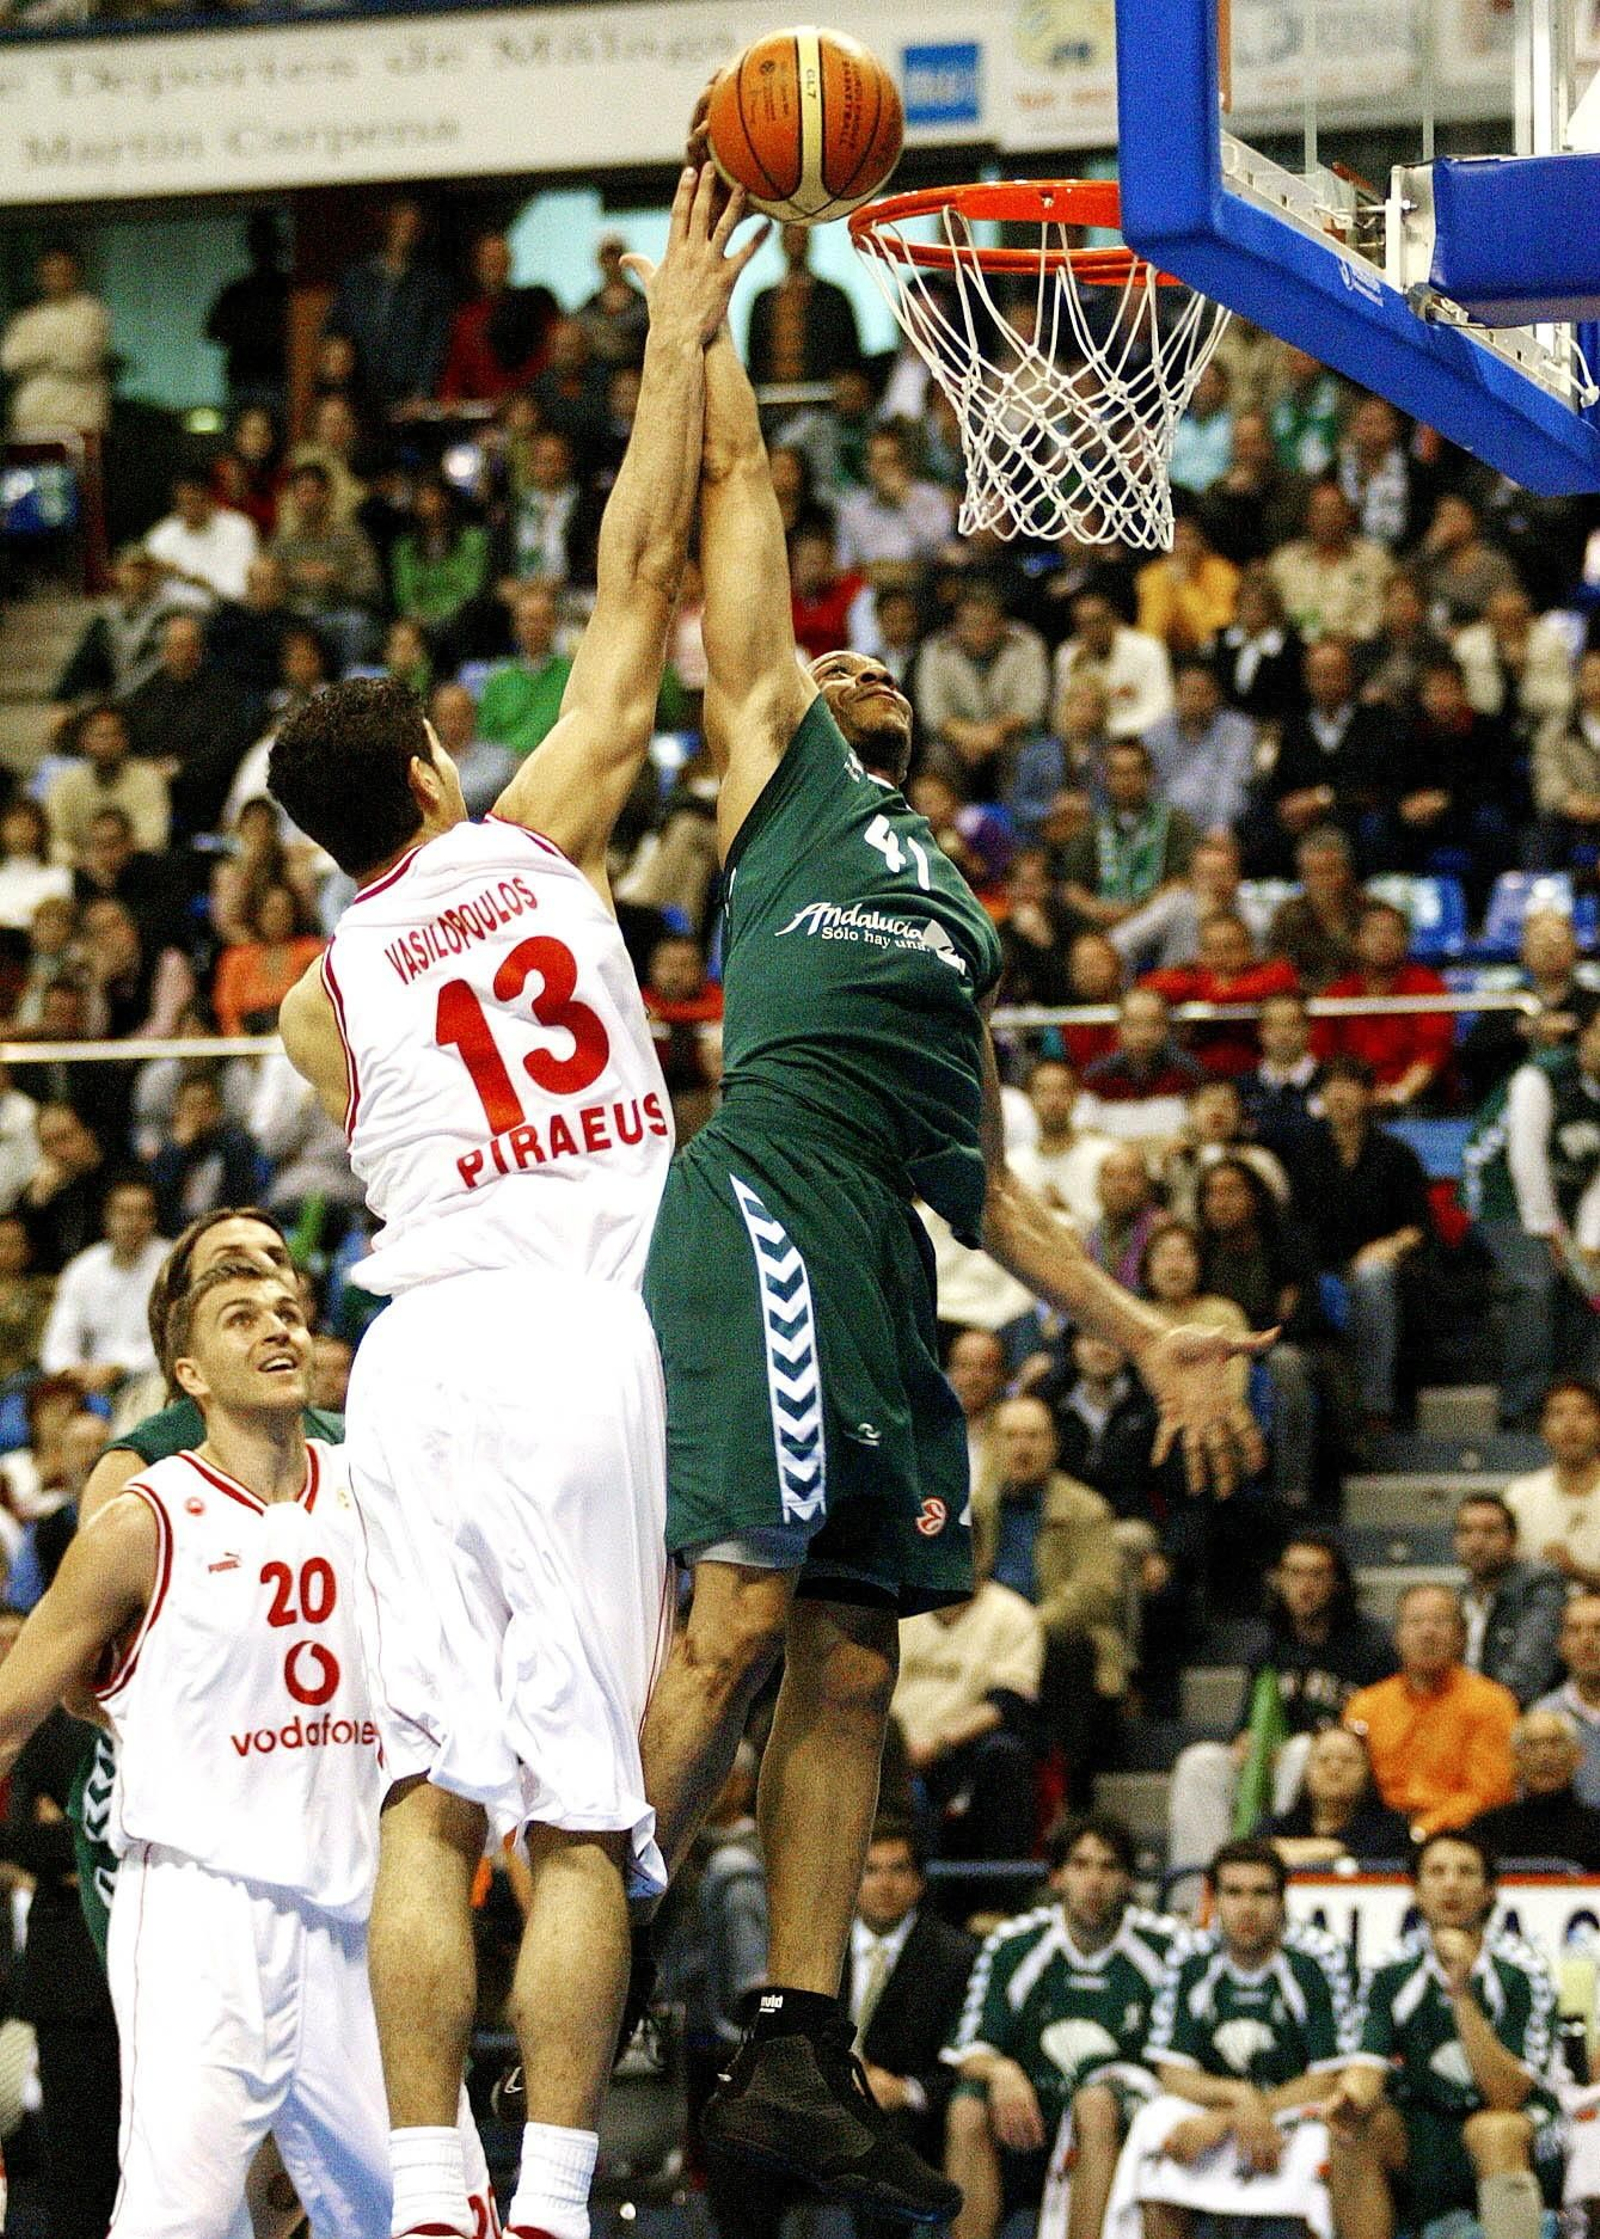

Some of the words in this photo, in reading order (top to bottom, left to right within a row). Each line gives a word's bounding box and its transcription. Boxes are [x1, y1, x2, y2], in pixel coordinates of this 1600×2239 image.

[384, 38, 467, 75] de
[864, 814, 930, 890] 41
[385, 877, 538, 985] VASILOPOULOS
[864, 930, 891, 949] hay
[435, 936, 609, 1137] 13
[457, 1092, 668, 1188] PIRAEUS
[260, 1557, 336, 1628] 20
